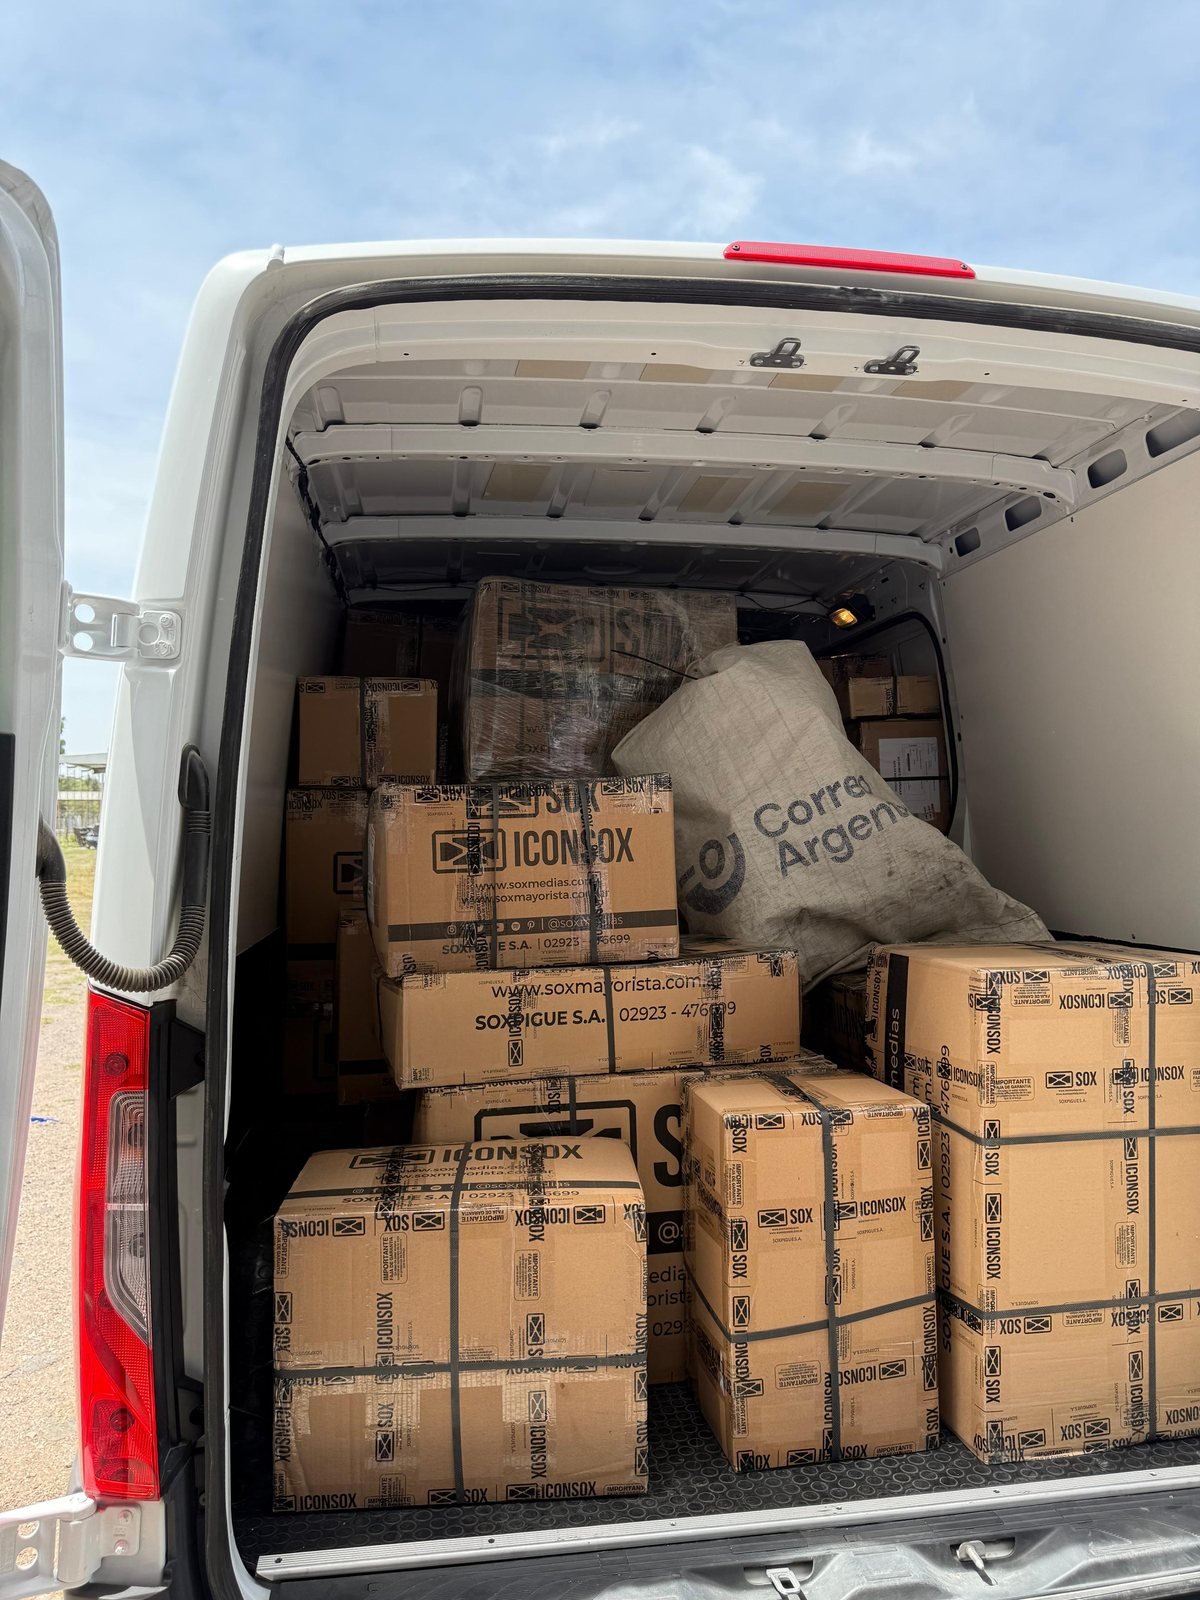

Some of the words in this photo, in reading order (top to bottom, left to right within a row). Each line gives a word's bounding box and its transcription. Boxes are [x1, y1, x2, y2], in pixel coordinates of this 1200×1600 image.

[398, 775, 431, 785] ICONSOX
[509, 940, 532, 951] S.A.
[543, 937, 580, 948] 02923
[1000, 971, 1020, 985] SOX
[1107, 964, 1147, 979] CONSOX
[871, 969, 882, 1014] ICONSOX
[1059, 993, 1105, 1010] ICONSOX
[475, 1011, 568, 1031] SOXPIGUE
[572, 1009, 606, 1025] S.A.
[619, 1006, 667, 1023] 02923
[889, 1007, 900, 1088] medias
[1075, 1071, 1097, 1087] SOX
[1141, 1065, 1185, 1082] ICONSOX
[1123, 1090, 1135, 1114] SOX
[802, 1112, 823, 1126] SOX
[867, 1110, 904, 1118] IMPORTANTE
[442, 1143, 584, 1165] ICONSOX
[940, 1131, 951, 1189] 02923
[985, 1152, 999, 1176] SOX
[921, 1185, 934, 1210] SOX
[1126, 1163, 1139, 1215] ICONSOX
[790, 1208, 813, 1224] SOX
[860, 1196, 906, 1216] ICONSOX
[384, 1215, 410, 1232] SOX
[462, 1214, 505, 1223] IMPORTANTE
[514, 1207, 570, 1227] ICONSOX
[986, 1226, 1001, 1280] ICONSOX
[733, 1254, 747, 1279] SOX
[377, 1292, 393, 1349] ICONSOX
[1000, 1318, 1021, 1335] SOX
[1066, 1316, 1102, 1325] IMPORTANTE
[275, 1327, 291, 1352] SOX
[734, 1330, 750, 1382] IONSOX
[779, 1378, 818, 1388] IMPORTANTE
[838, 1366, 877, 1386] ICONSO
[985, 1379, 1001, 1403] SOX
[377, 1402, 394, 1428] SOX
[926, 1406, 938, 1431] SOX
[1130, 1383, 1144, 1436] ICONSOX
[1166, 1406, 1200, 1425] ONSOX
[1060, 1423, 1082, 1441] SOX
[530, 1426, 547, 1479] ICONSOX
[876, 1443, 913, 1453] IMPORTANTE
[464, 1488, 488, 1503] SOX
[542, 1481, 597, 1498] ICONSOX
[300, 1493, 357, 1510] ICONSOX
